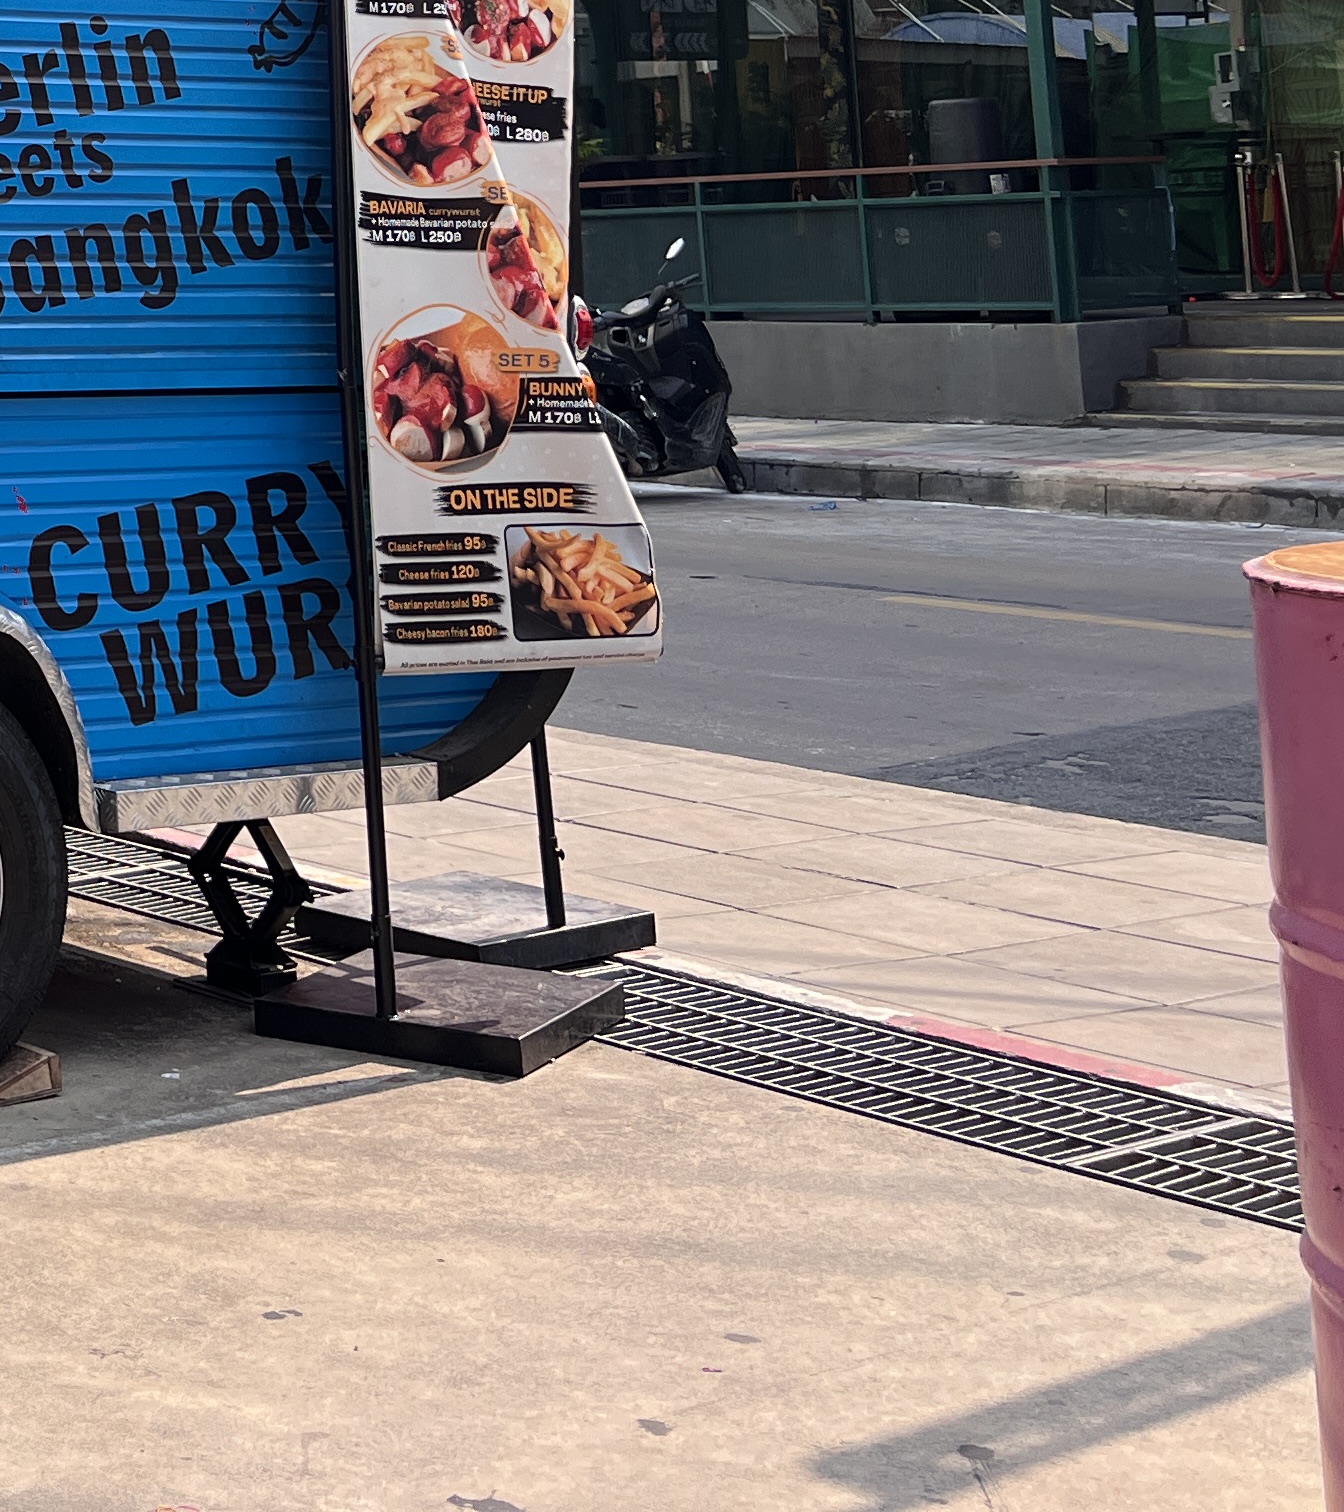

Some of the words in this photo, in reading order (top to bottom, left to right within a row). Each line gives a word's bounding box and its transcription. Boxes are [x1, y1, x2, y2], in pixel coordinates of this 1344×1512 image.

[369, 2, 379, 13] M
[423, 2, 431, 14] L
[528, 89, 548, 104] UP
[507, 126, 514, 139] L
[370, 200, 426, 216] BAVARIA
[378, 217, 419, 228] Homemade
[420, 216, 453, 228] Bavarian
[455, 219, 487, 229] potato
[372, 230, 384, 241] M
[421, 230, 428, 242] L
[498, 353, 535, 367] SET
[539, 354, 550, 367] 5
[529, 382, 583, 396] BUNNY
[528, 411, 541, 423] M
[450, 489, 482, 511] ON
[483, 488, 521, 510] THE
[524, 487, 574, 509] SIDE
[398, 569, 430, 580] Cheese
[431, 569, 449, 579] fries
[99, 577, 354, 727] WUR
